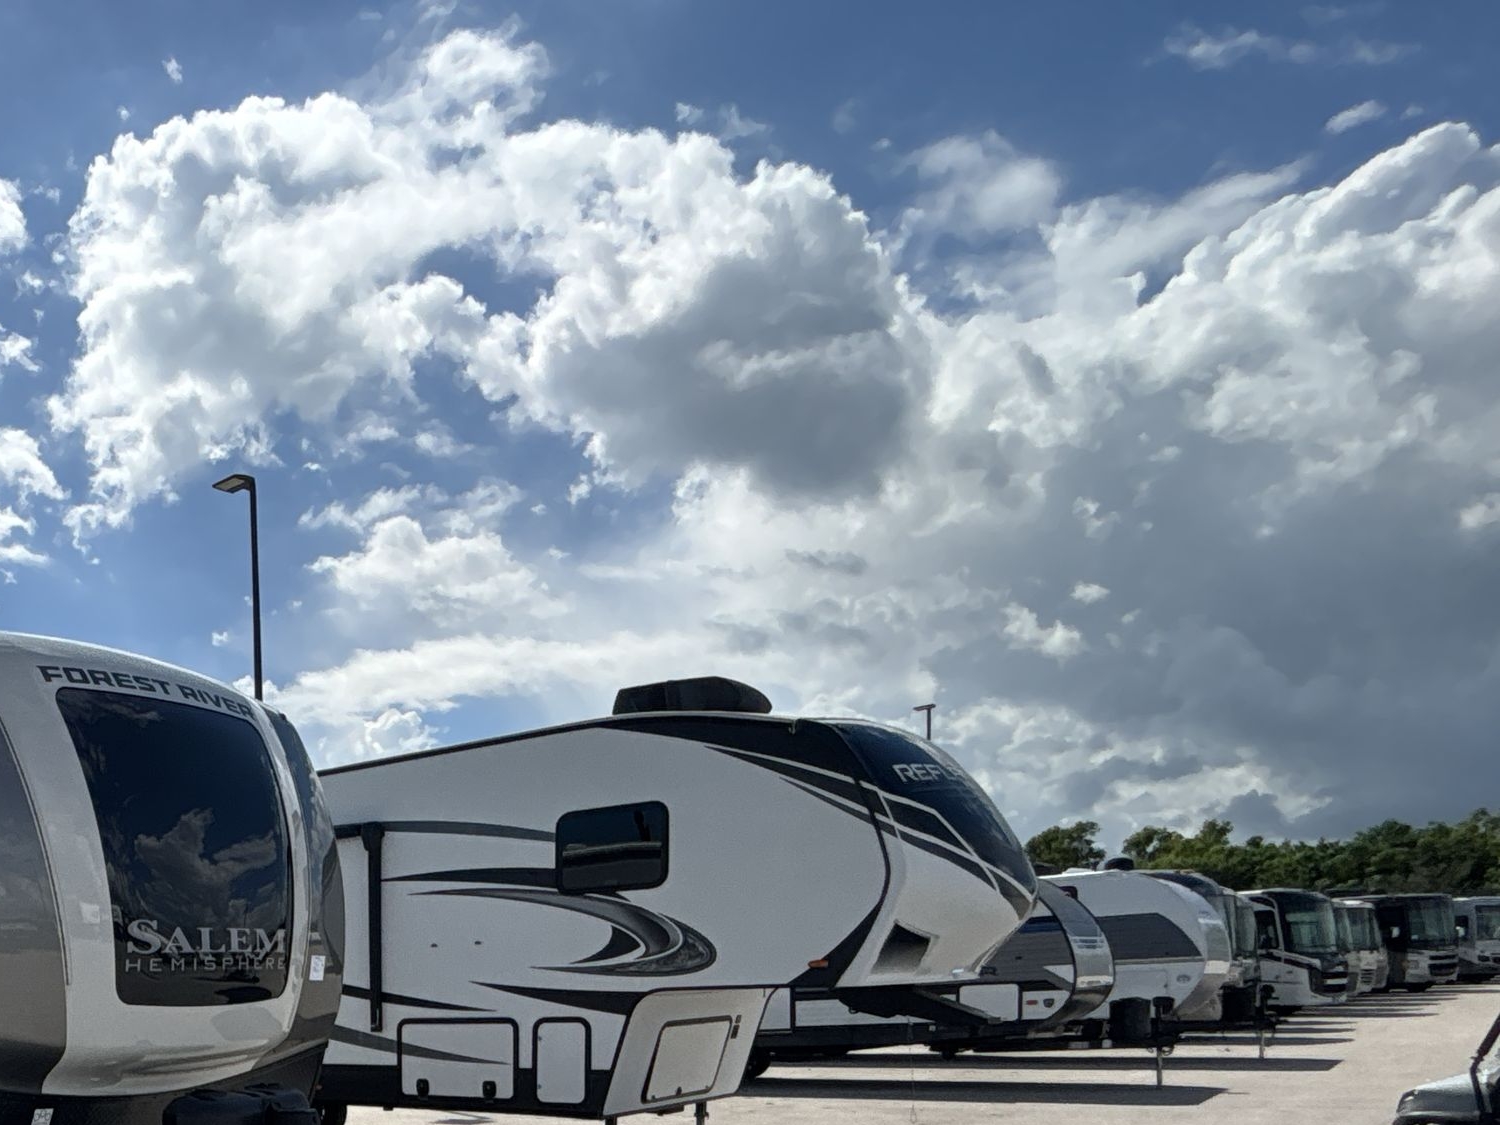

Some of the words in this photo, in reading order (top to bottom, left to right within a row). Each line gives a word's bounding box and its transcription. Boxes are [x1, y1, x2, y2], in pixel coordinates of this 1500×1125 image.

[35, 665, 171, 696] FOREST
[176, 683, 257, 721] RIVER
[126, 919, 287, 955] SALEM
[125, 956, 287, 973] HEMISPHERE
